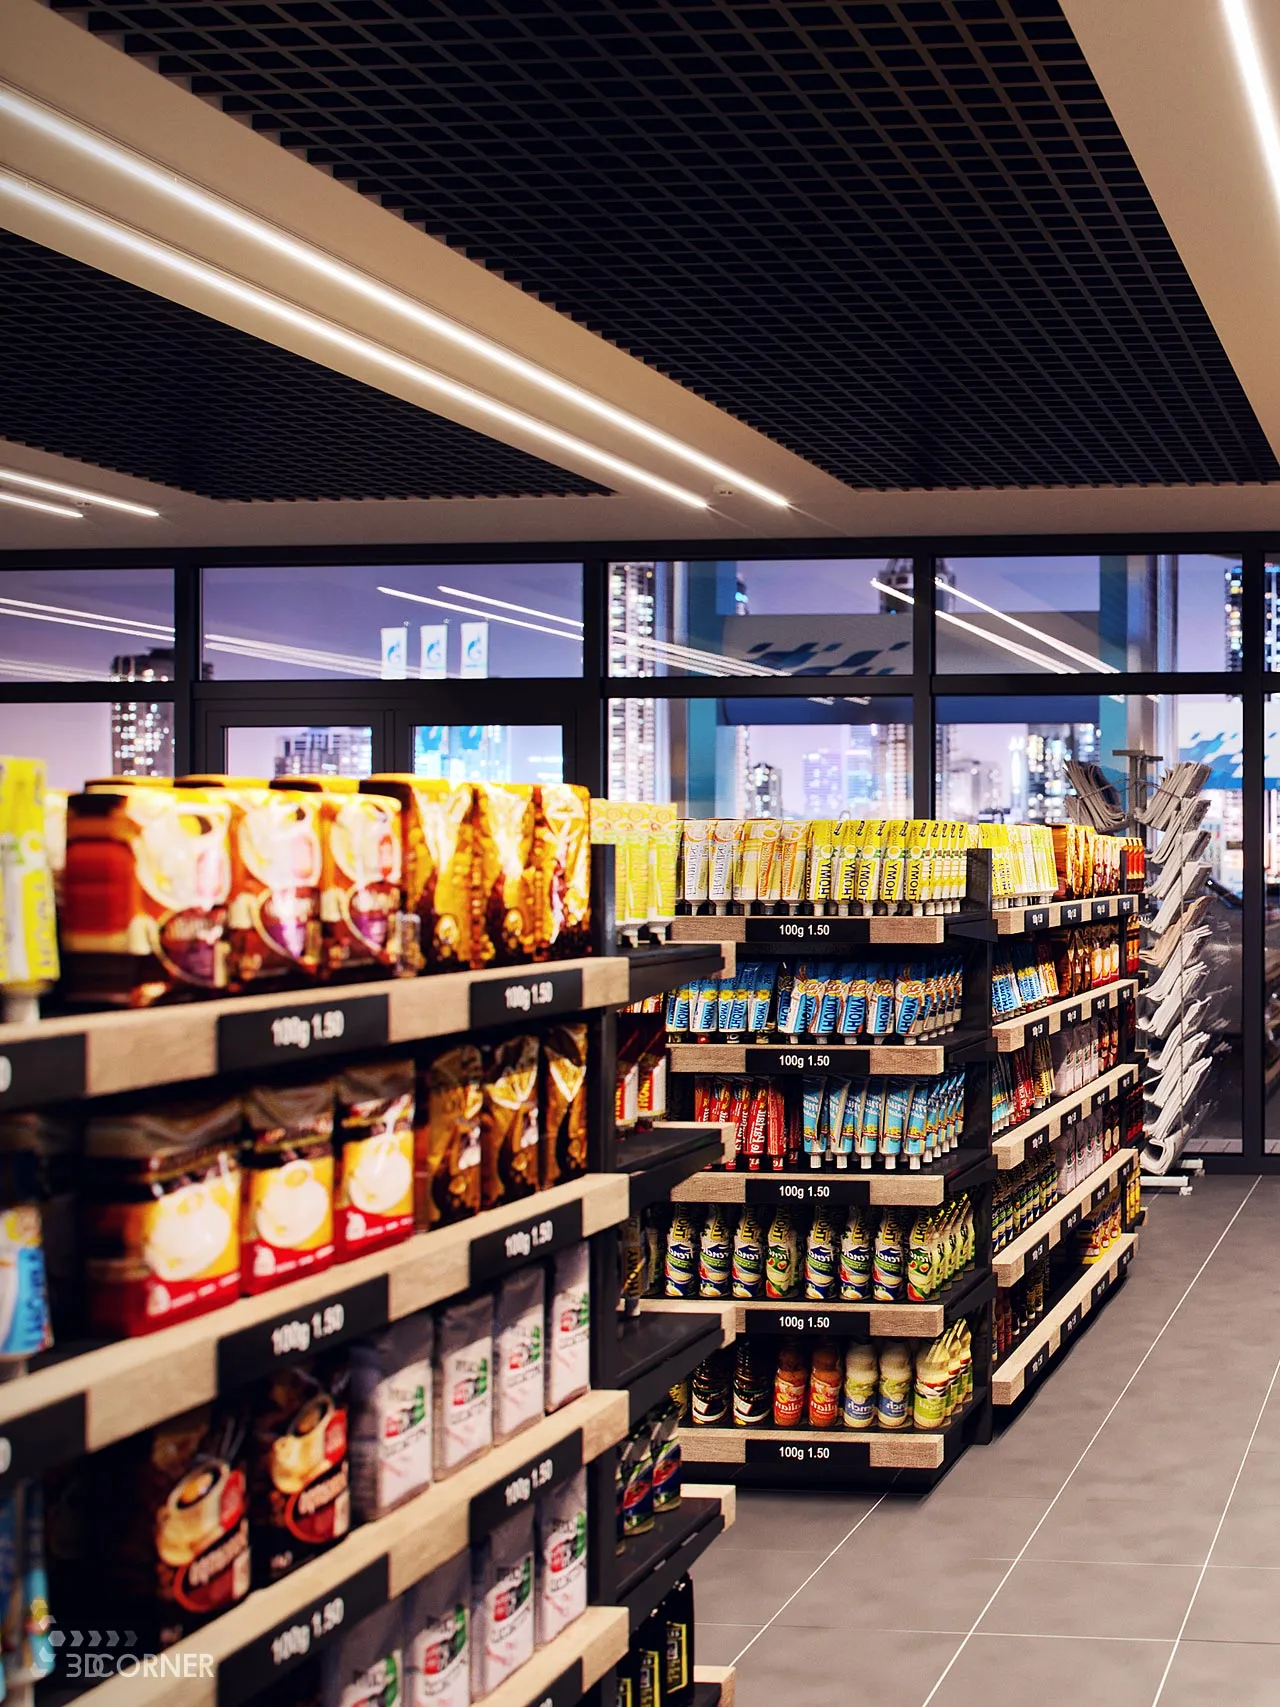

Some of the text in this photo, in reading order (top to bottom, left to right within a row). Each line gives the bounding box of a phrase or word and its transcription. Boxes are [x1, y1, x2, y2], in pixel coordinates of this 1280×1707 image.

[779, 924, 830, 938] 100g 1.50
[779, 1054, 830, 1069] 100g 1.50
[779, 1185, 830, 1200] 100g 1.50
[779, 1315, 830, 1330] 100g 1.50
[779, 1446, 830, 1461] 100g 1.50
